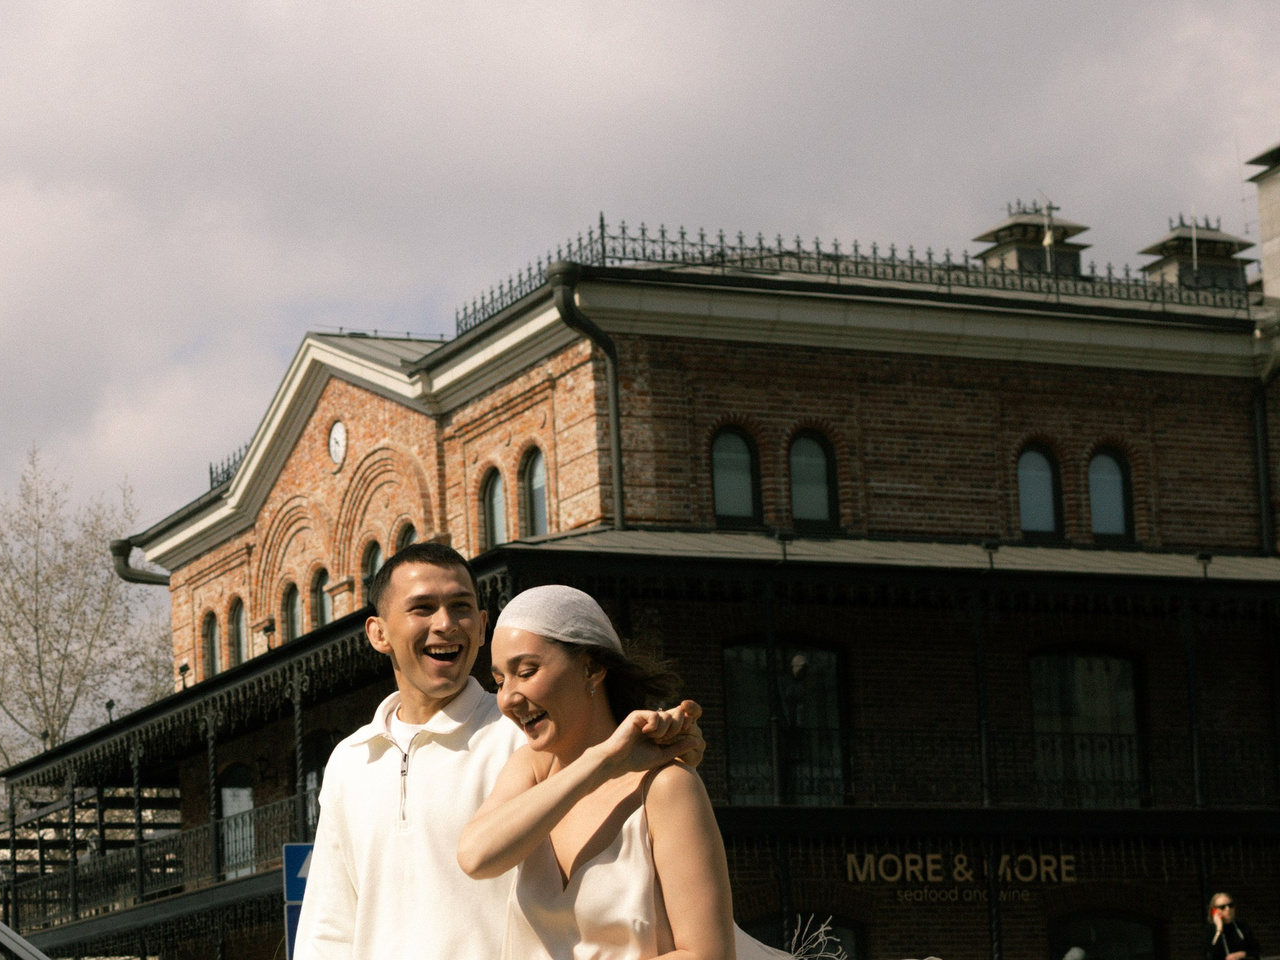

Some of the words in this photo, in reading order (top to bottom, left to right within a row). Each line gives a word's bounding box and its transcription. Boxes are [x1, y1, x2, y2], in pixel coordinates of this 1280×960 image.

[846, 853, 943, 882] MORE
[952, 854, 974, 882] &
[896, 886, 958, 902] seafood
